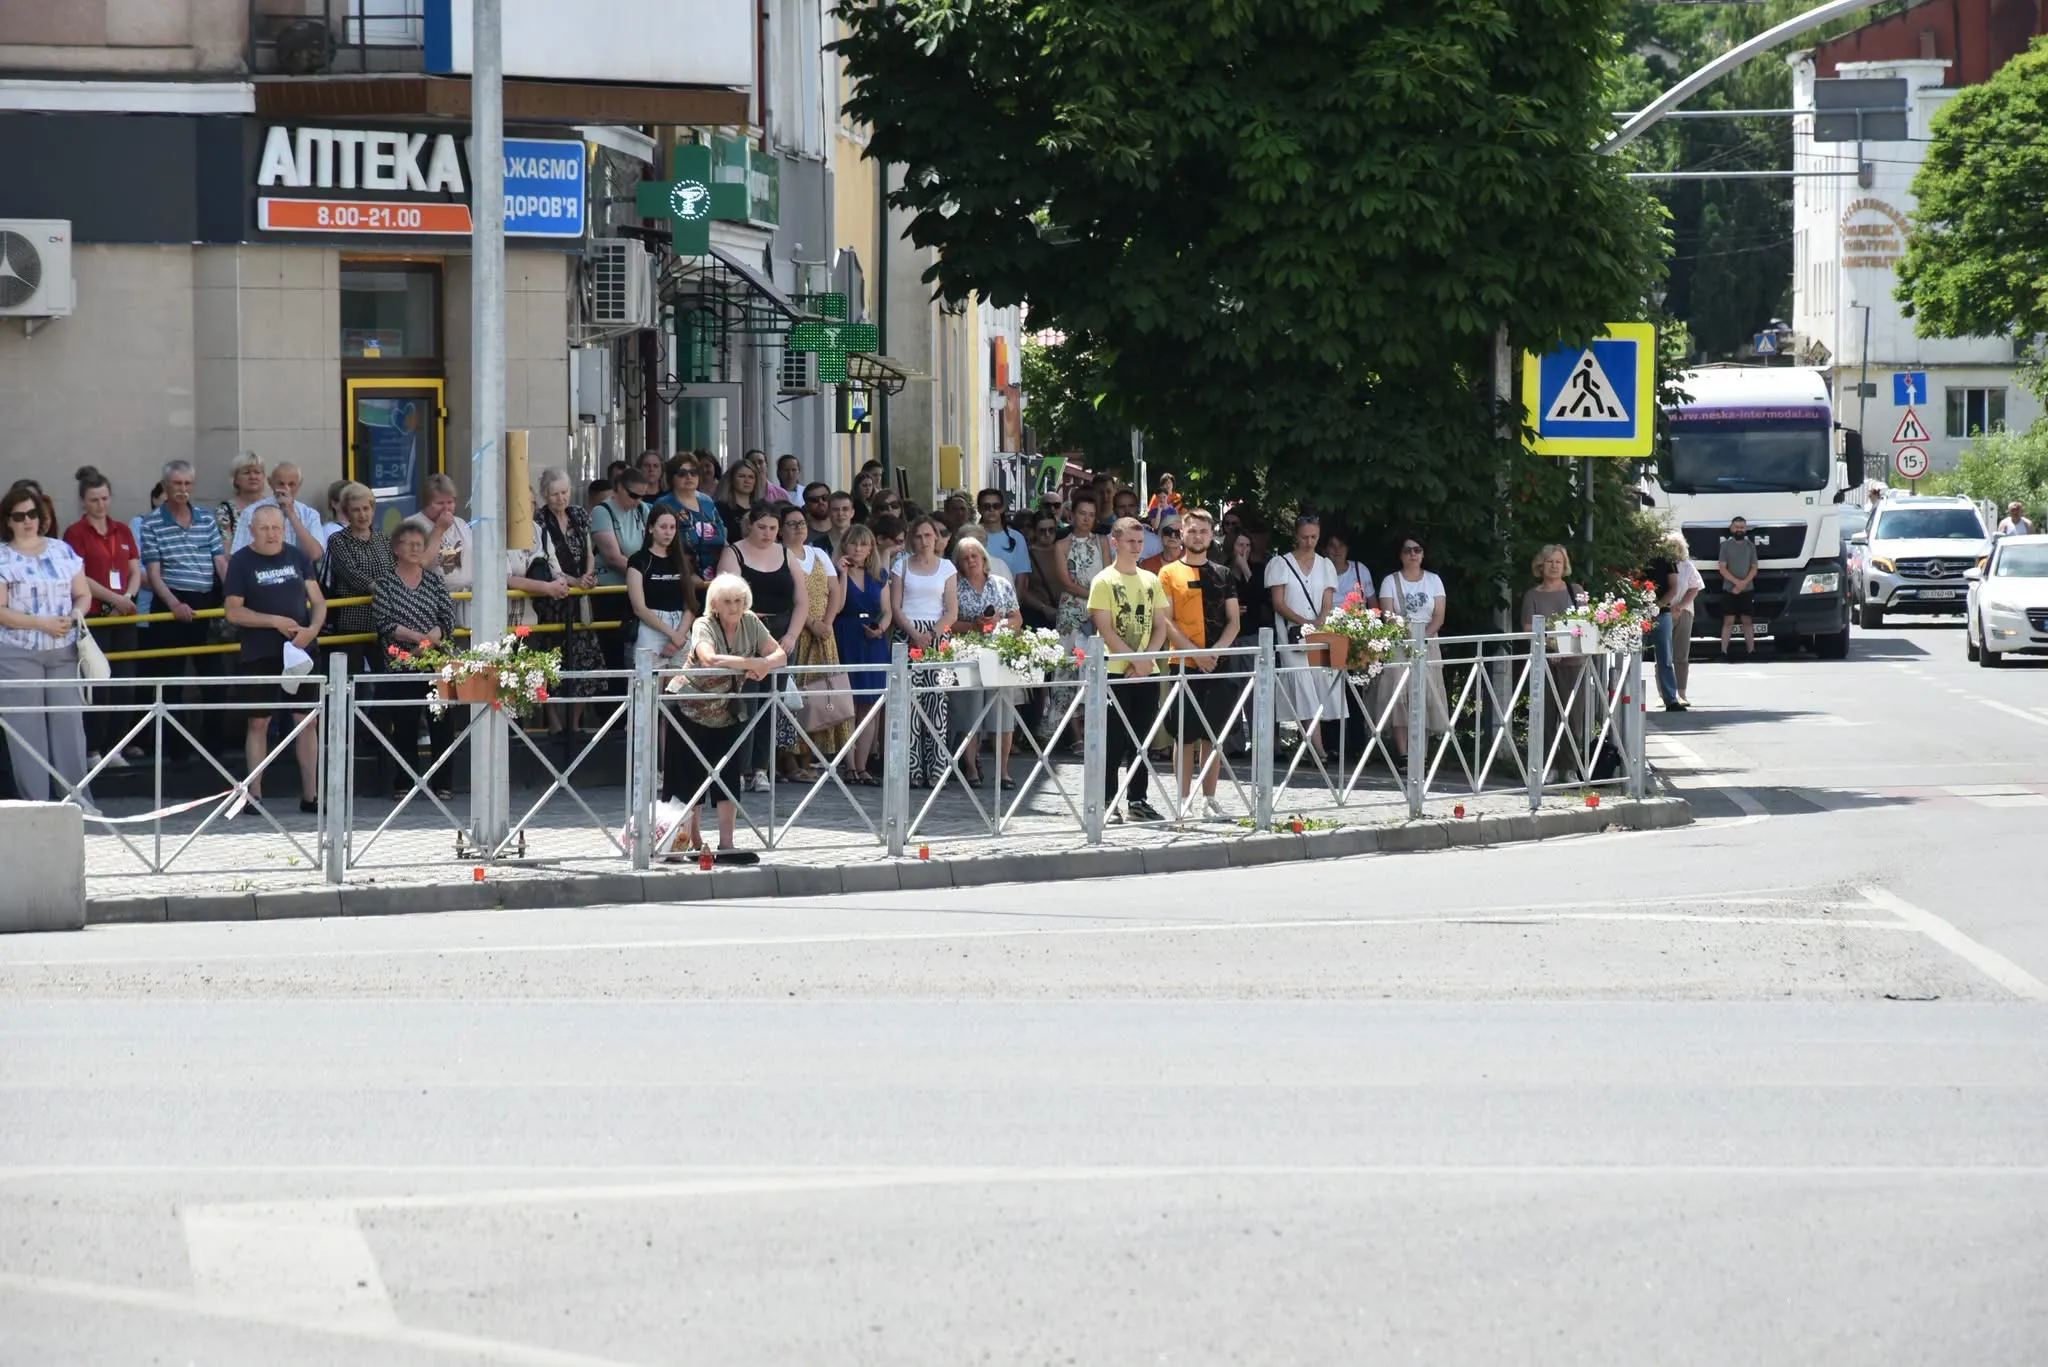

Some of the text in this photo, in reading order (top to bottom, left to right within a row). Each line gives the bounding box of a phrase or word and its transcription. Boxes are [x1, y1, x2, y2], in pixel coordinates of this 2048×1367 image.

[257, 126, 464, 192] АПТЕКА
[503, 156, 579, 181] ЖАЄМО
[317, 207, 421, 227] 8.00-21.00
[503, 195, 578, 221] ДОРОВ'Я
[1903, 455, 1917, 468] 15
